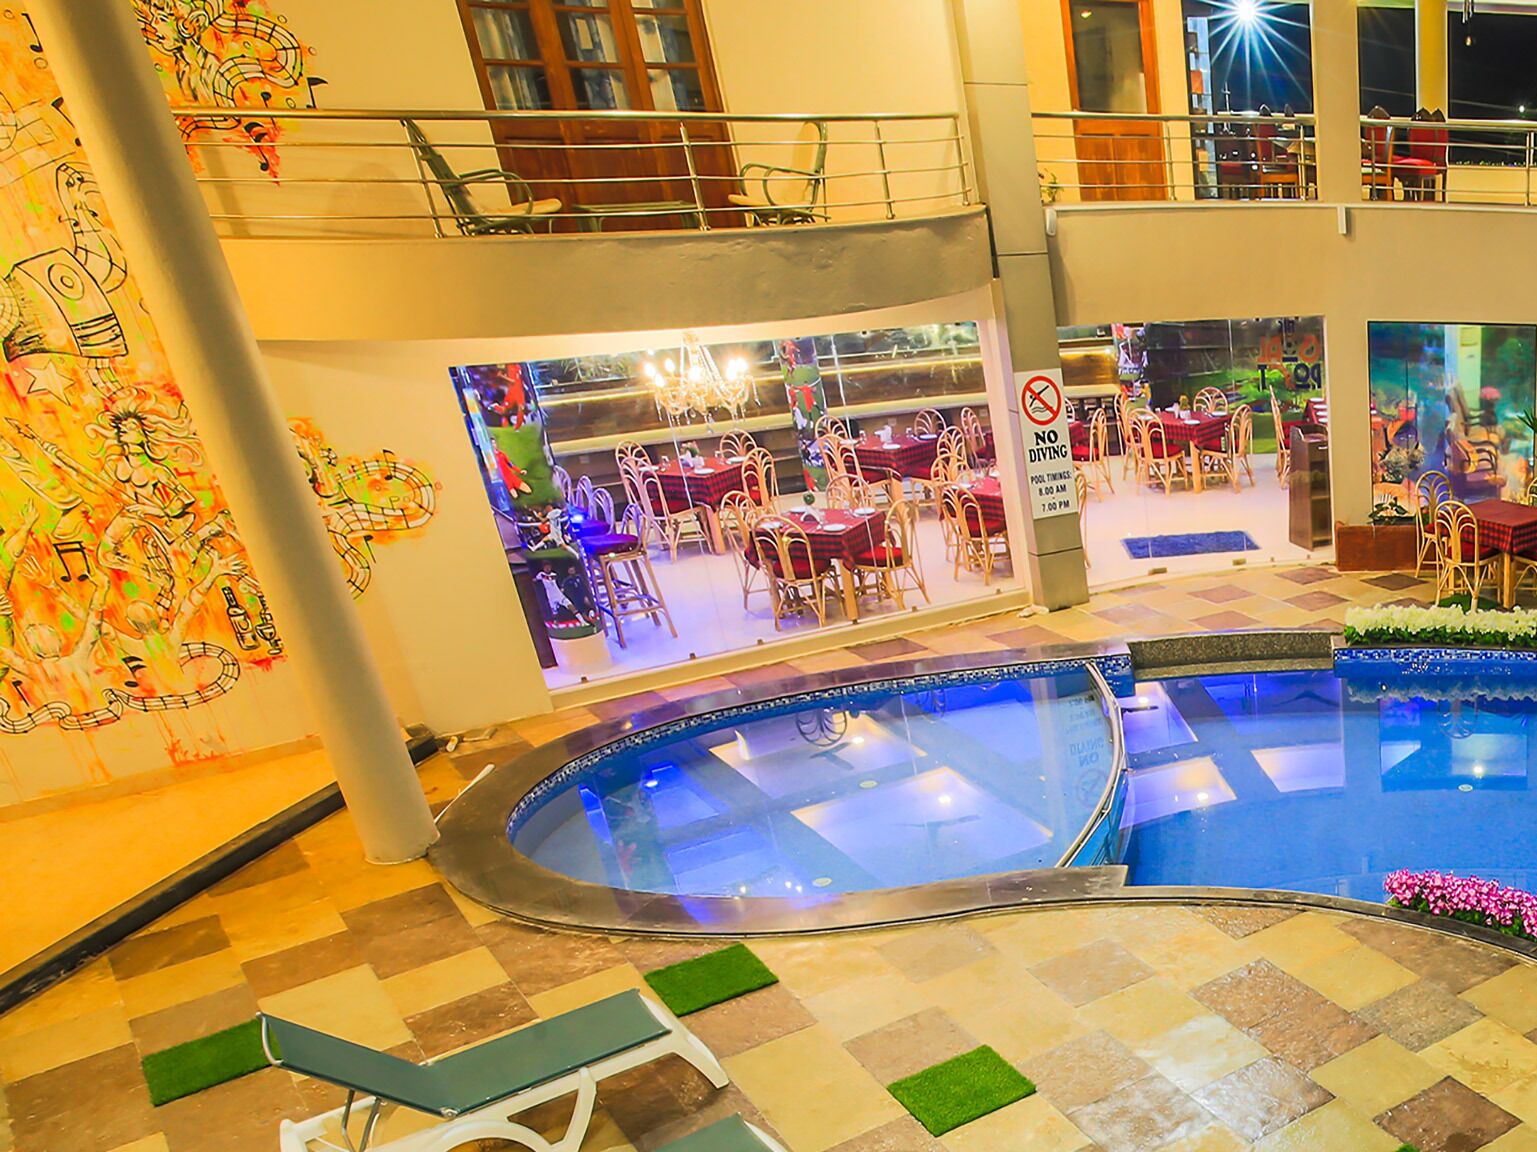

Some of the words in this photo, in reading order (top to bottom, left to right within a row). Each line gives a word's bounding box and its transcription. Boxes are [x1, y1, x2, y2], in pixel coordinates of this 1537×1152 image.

[1034, 430, 1058, 446] NO
[1029, 445, 1067, 463] DIVING
[1031, 474, 1046, 484] POOL
[1056, 484, 1066, 493] AM
[1059, 499, 1070, 509] PM
